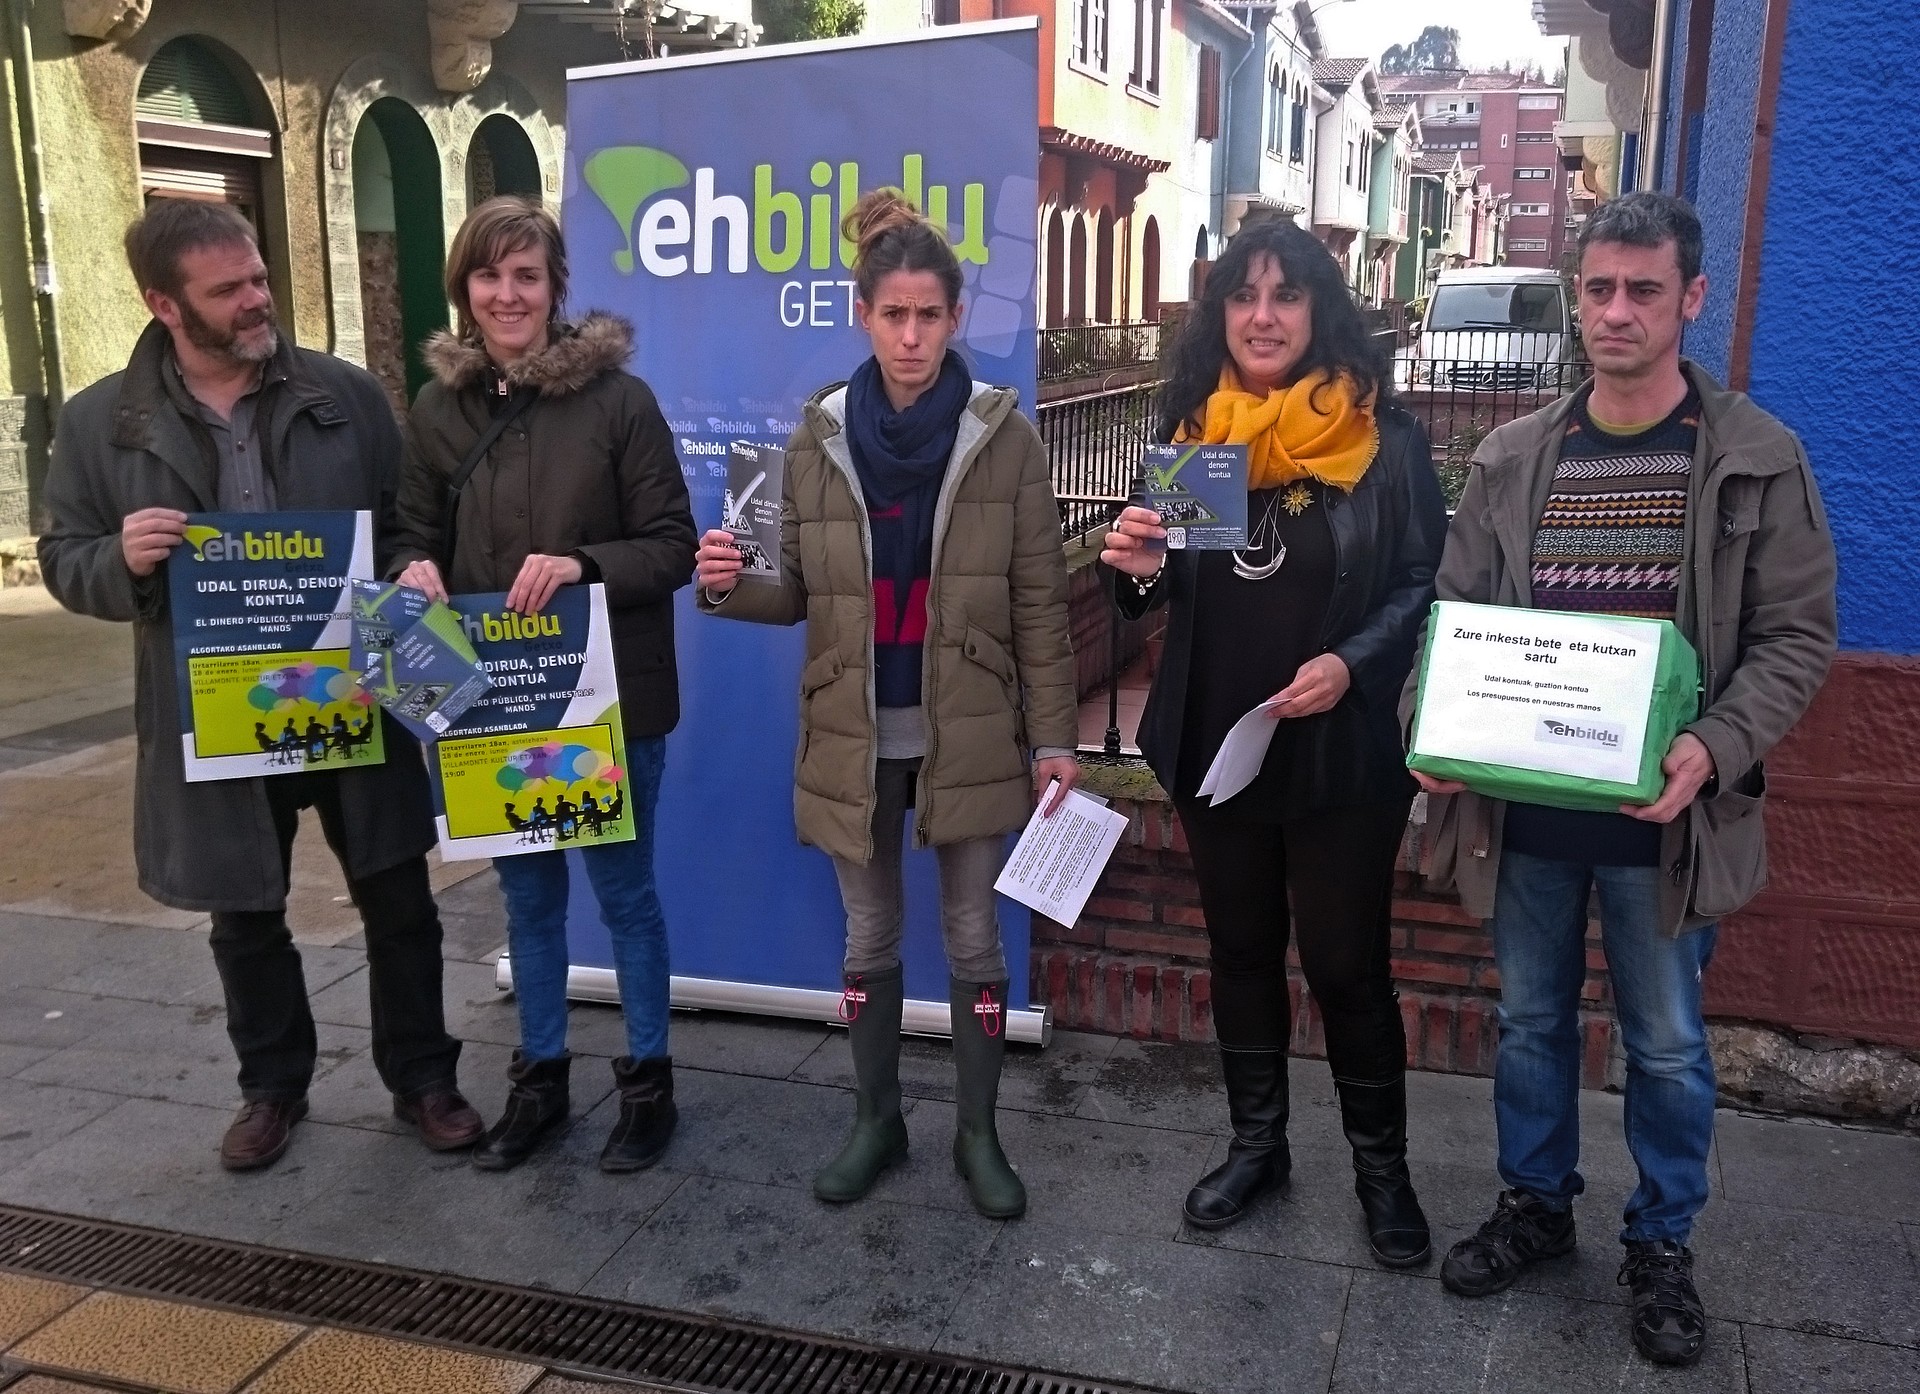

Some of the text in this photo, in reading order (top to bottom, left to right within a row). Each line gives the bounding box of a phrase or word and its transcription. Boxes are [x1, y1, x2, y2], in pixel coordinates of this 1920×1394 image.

[779, 281, 857, 327] GET
[667, 421, 697, 433] bildu
[713, 420, 757, 434] ehbildu
[772, 421, 798, 434] ehbil
[686, 441, 726, 455] ehbildu
[1201, 451, 1237, 460] Udal dirua,
[1208, 461, 1229, 469] denon
[1208, 471, 1231, 479] kontua
[750, 497, 763, 506] Udal
[754, 507, 773, 516] denon
[754, 515, 774, 525] kontua
[203, 531, 324, 561] ehbildu
[285, 563, 324, 573] Getxo
[197, 577, 348, 593] UDAL DIRUA, DENON
[245, 594, 305, 607] KONTUA
[195, 612, 351, 627] EL DINERO PÚBLICO, EN NUESTRAS
[260, 624, 291, 633] MANOS
[463, 610, 561, 643] hbildu
[1453, 628, 1637, 658] Zure inkesta bete eta kutxan
[190, 645, 235, 655] ALGORTAKO
[484, 652, 588, 673] DIRUA, DENON
[1524, 652, 1557, 665] sartu
[194, 676, 240, 686] VILLAMONTE
[242, 674, 269, 683] KULTUR
[489, 674, 547, 688] KONTUA
[1484, 674, 1501, 684] Udal
[1502, 676, 1533, 687] kontuak,
[1564, 682, 1589, 693] kontua
[492, 694, 531, 706] PÚBLICO,
[535, 692, 547, 701] EN
[549, 688, 595, 700] NUESTRAS
[1467, 689, 1602, 712] Los presupuestos en nuestras manos
[505, 703, 536, 714] MANOS
[439, 728, 482, 738] ALGORTAKO
[1553, 725, 1619, 743] ehbildu
[443, 759, 488, 769] VILLAMONTE
[490, 756, 517, 764] KULTUR
[444, 770, 466, 778] 19:00
